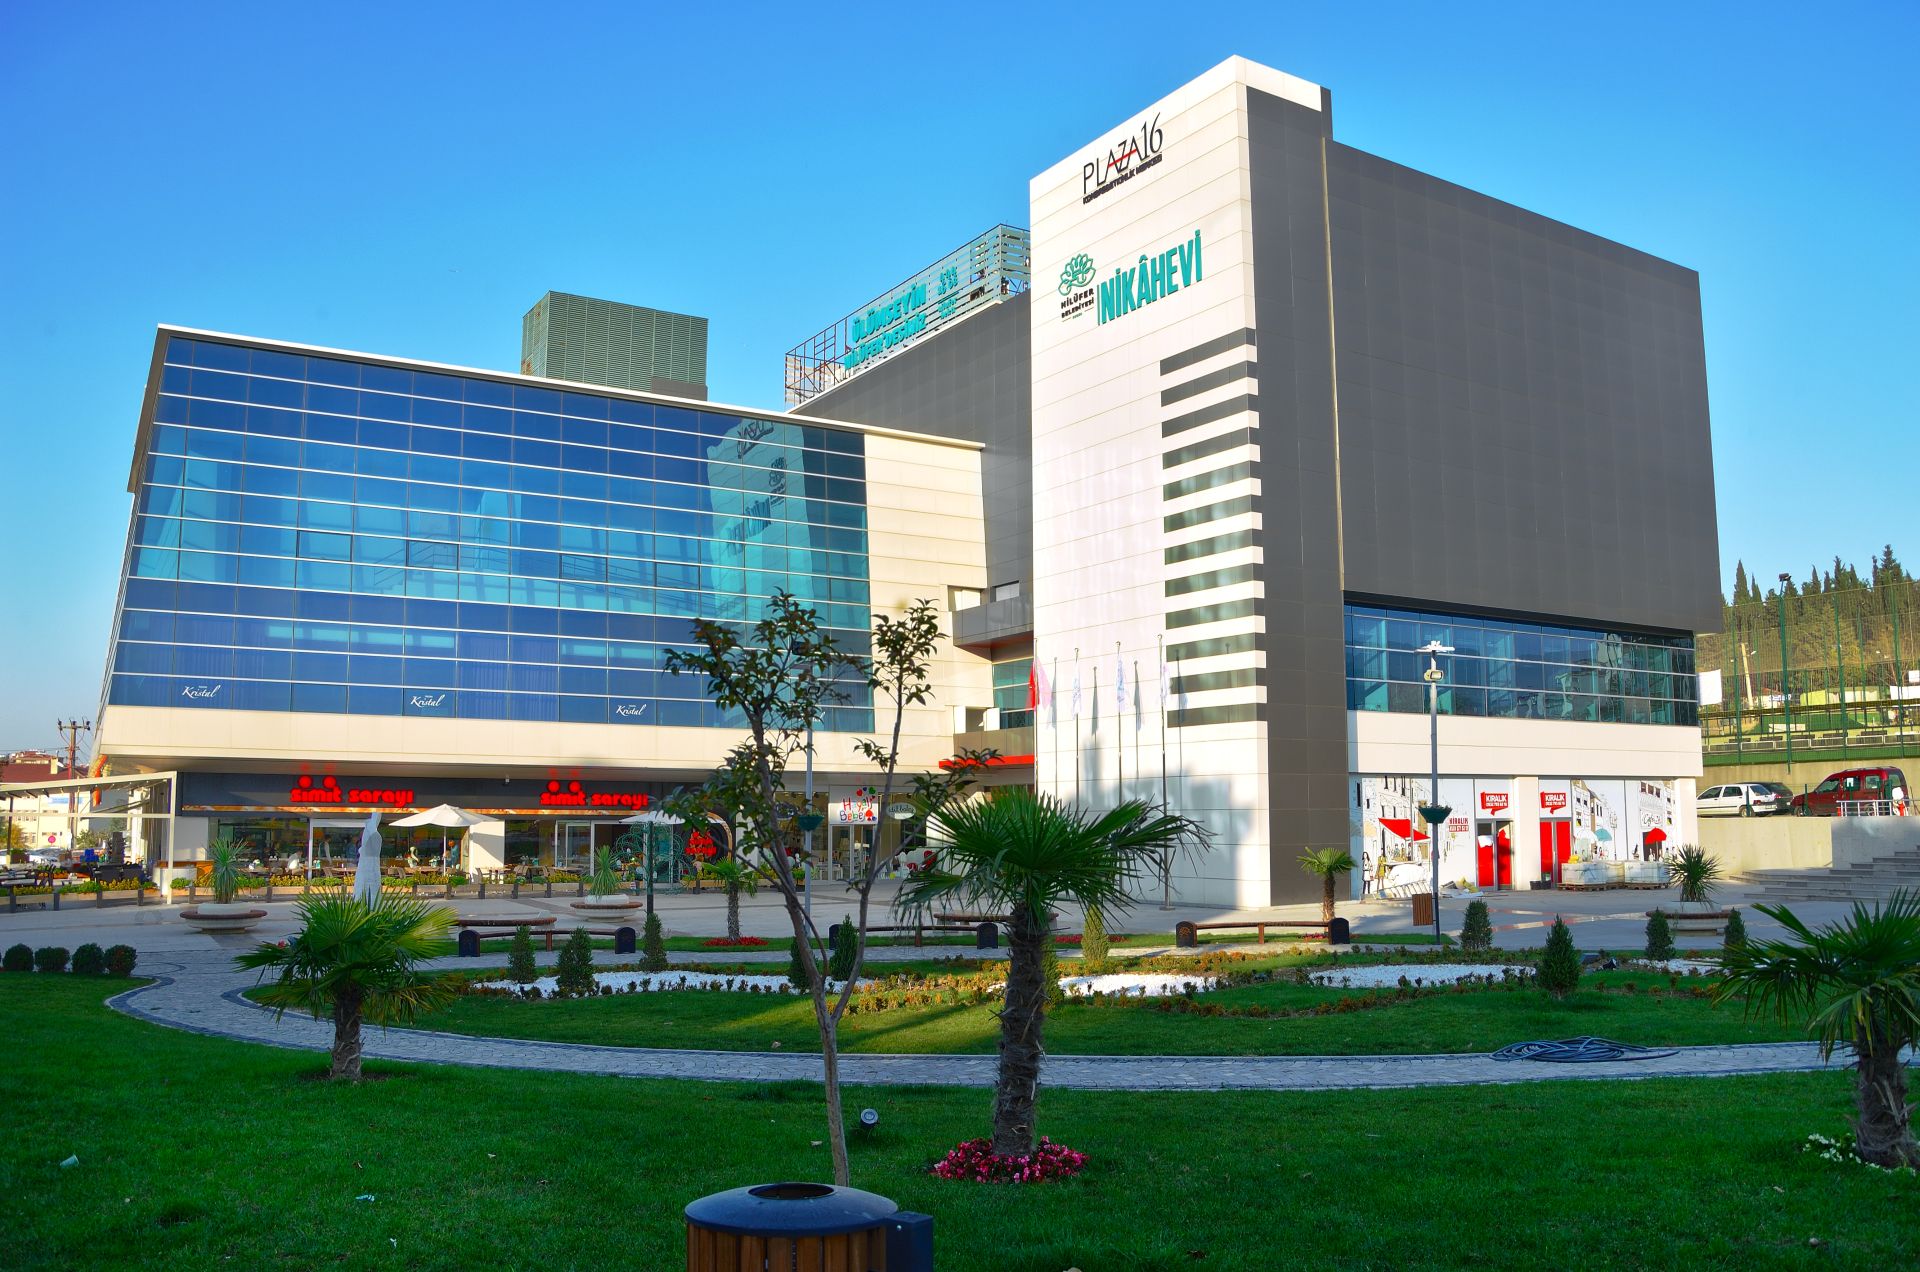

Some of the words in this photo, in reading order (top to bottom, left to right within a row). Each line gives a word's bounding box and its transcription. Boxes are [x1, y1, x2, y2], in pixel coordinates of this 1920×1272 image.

[1100, 229, 1203, 325] NİKÂHEVİ
[1061, 288, 1094, 309] NİLÜFER
[182, 684, 221, 699] Kristal
[410, 694, 446, 708] Kristal
[615, 703, 647, 717] Kristal
[290, 776, 342, 802] simit
